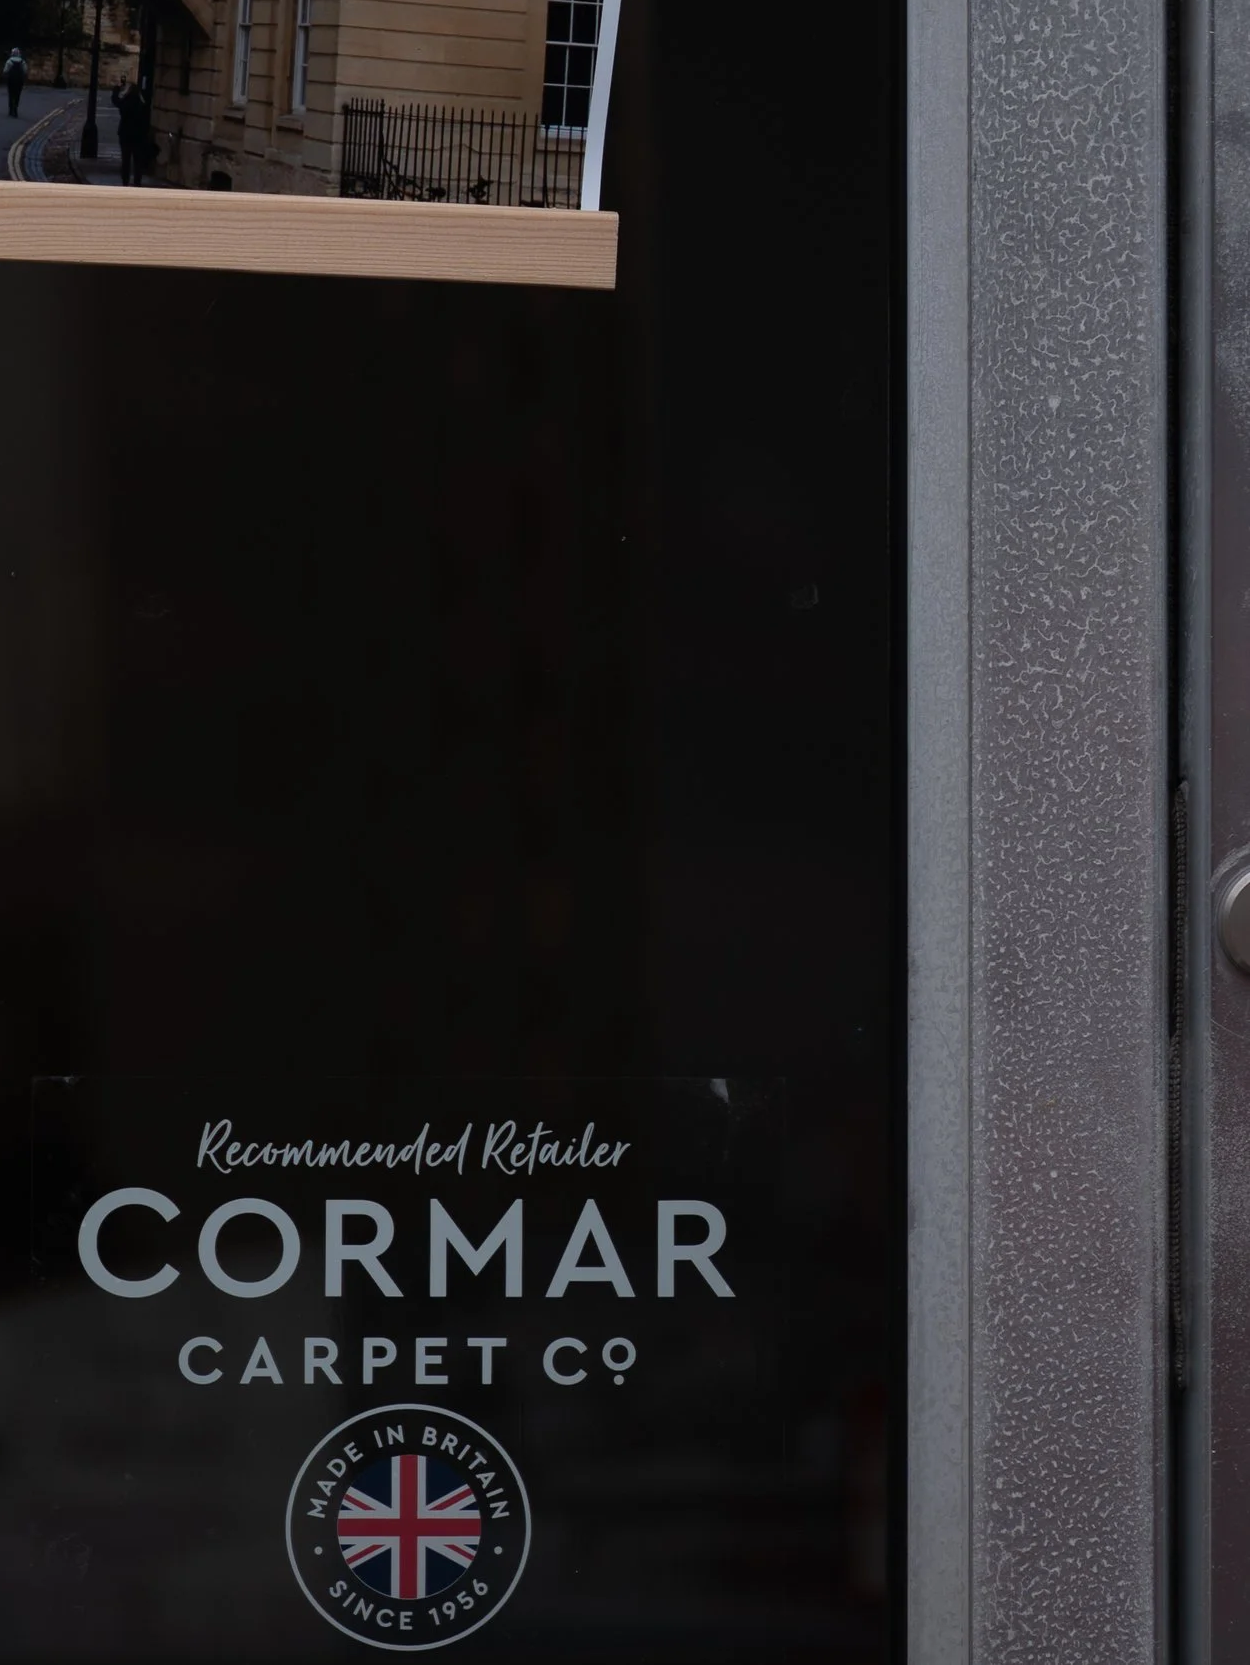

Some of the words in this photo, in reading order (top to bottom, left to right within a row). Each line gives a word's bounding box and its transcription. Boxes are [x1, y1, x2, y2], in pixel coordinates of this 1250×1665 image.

[197, 1119, 472, 1175] Recommended
[482, 1120, 630, 1175] Retailer
[78, 1188, 735, 1298] CORMAR
[179, 1336, 507, 1384] CARPET
[307, 1442, 364, 1519] MADE
[374, 1425, 404, 1447] IN
[421, 1426, 511, 1520] BRITAIN
[328, 1579, 414, 1631] SINCE
[427, 1578, 491, 1627] 1956
